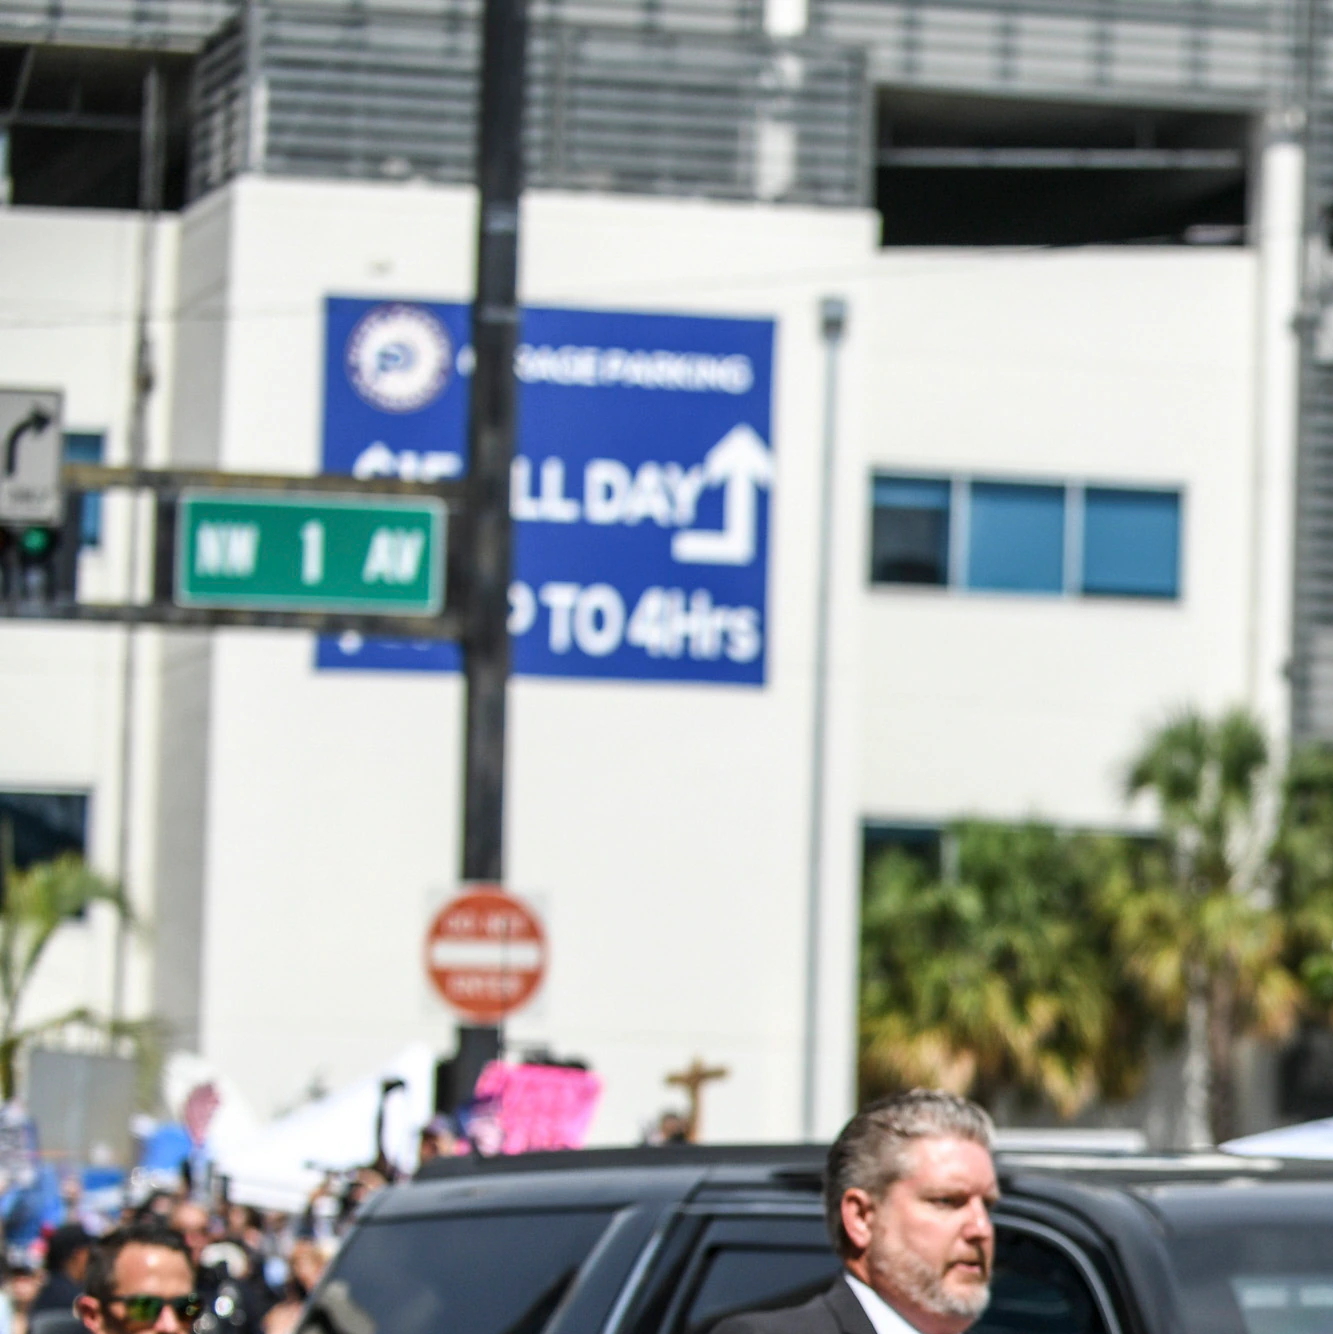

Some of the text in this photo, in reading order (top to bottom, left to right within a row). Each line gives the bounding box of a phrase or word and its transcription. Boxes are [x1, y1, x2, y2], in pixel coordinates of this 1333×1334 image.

[509, 454, 581, 524] LL
[583, 457, 703, 528] DAY
[195, 519, 426, 586] NW 1 AV
[538, 580, 626, 658] TO
[626, 585, 762, 664] 4Hrs
